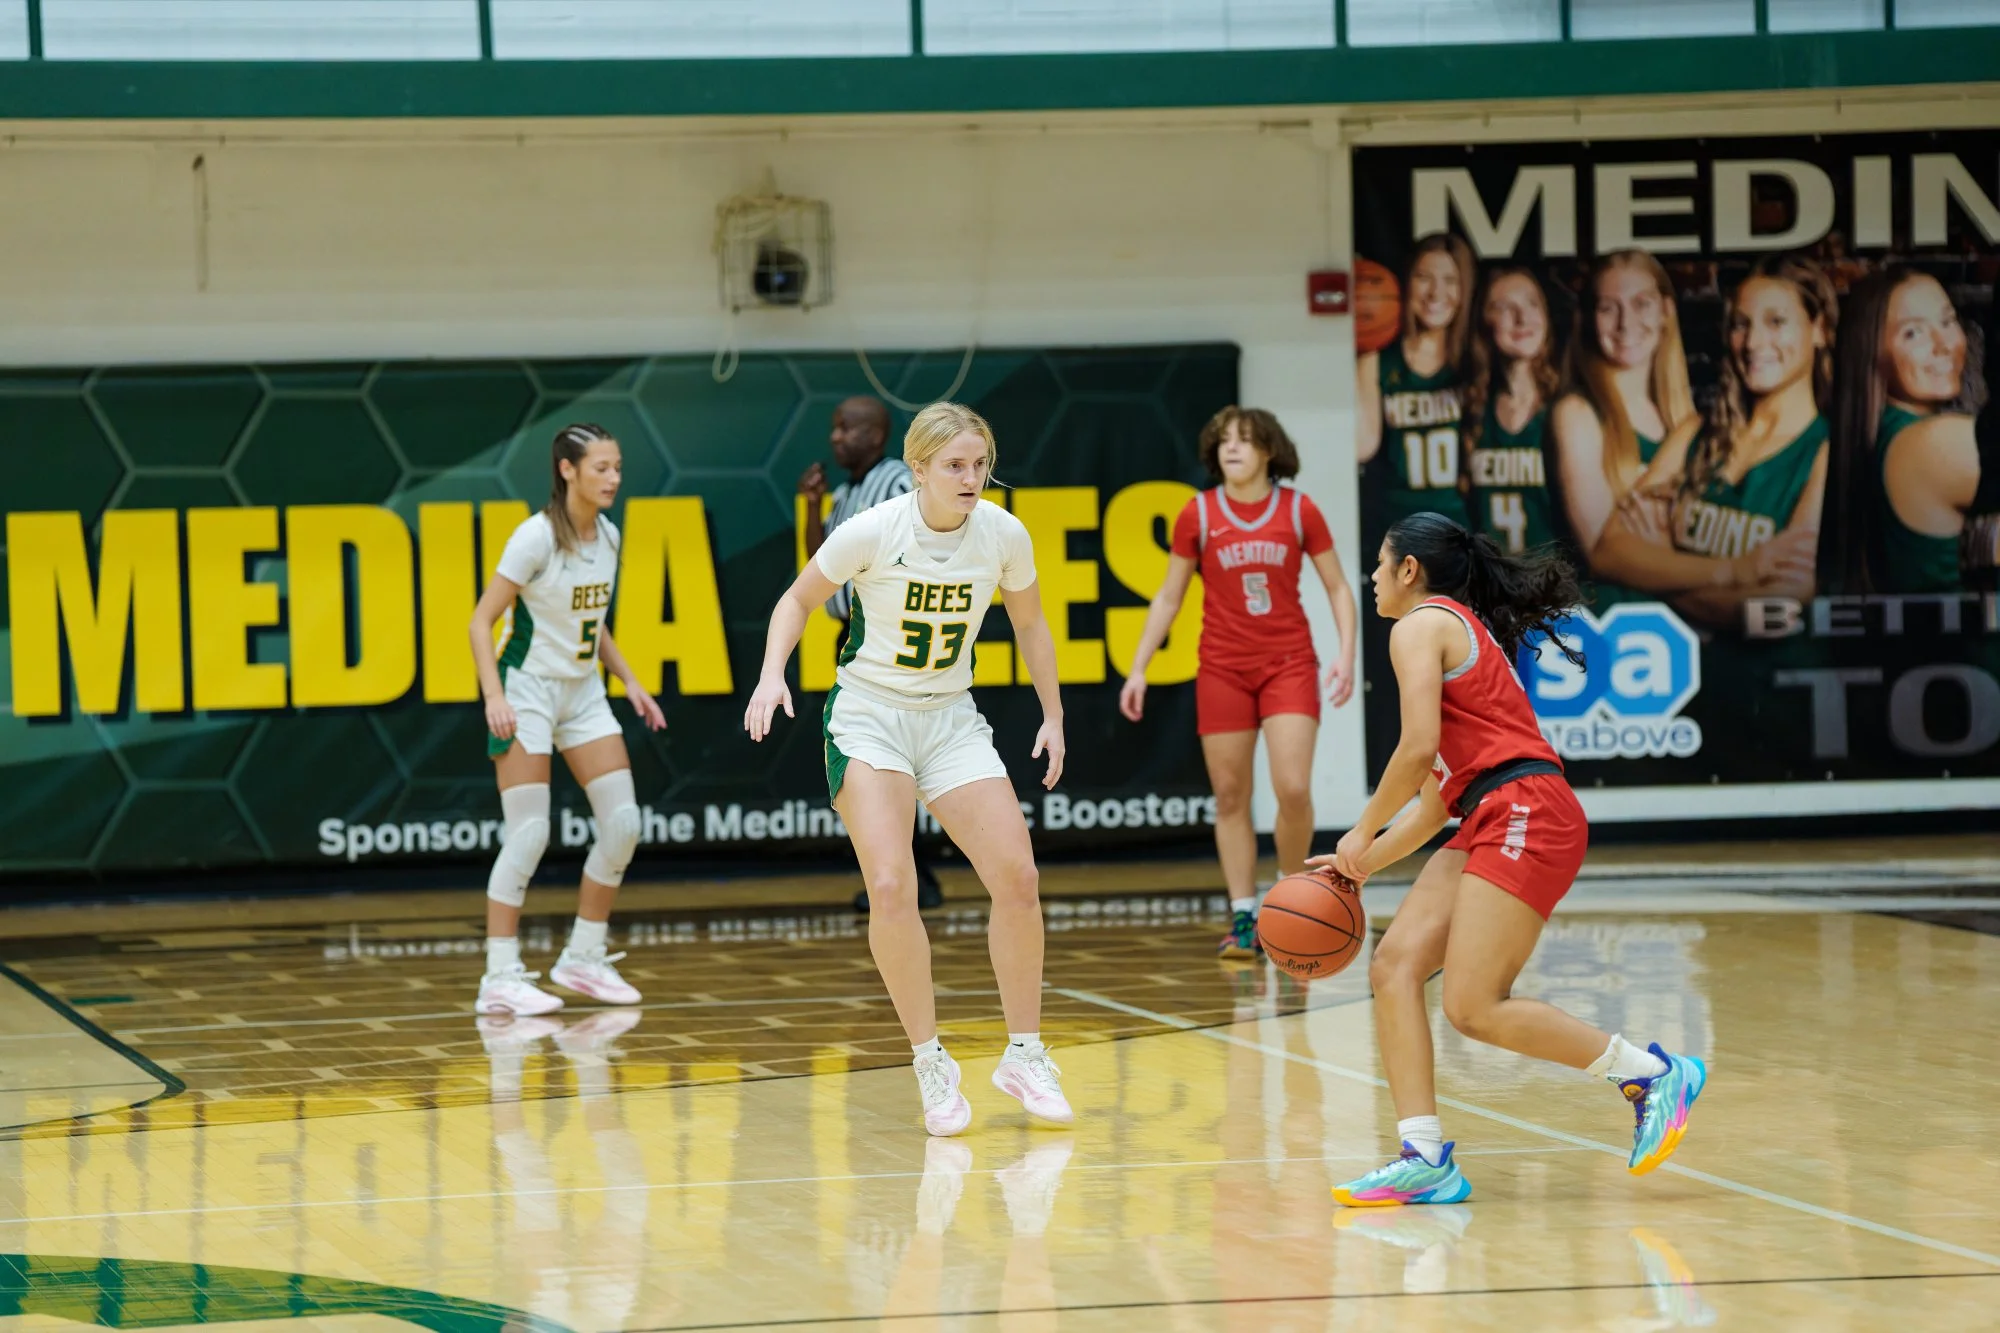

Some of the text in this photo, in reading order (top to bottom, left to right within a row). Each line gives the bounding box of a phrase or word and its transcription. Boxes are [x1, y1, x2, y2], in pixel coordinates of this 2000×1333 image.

[1404, 426, 1459, 490] 10
[1489, 491, 1527, 553] 4
[1216, 540, 1289, 571] MENTOR
[5, 495, 735, 717] MEDIA
[570, 582, 610, 612] BEES
[904, 580, 973, 613] BEES
[1242, 572, 1273, 616] 5
[576, 617, 599, 662] 5
[894, 618, 968, 671] 33
[318, 817, 504, 863] Sponsor
[640, 804, 696, 844] he
[1043, 794, 1218, 832] Boosters
